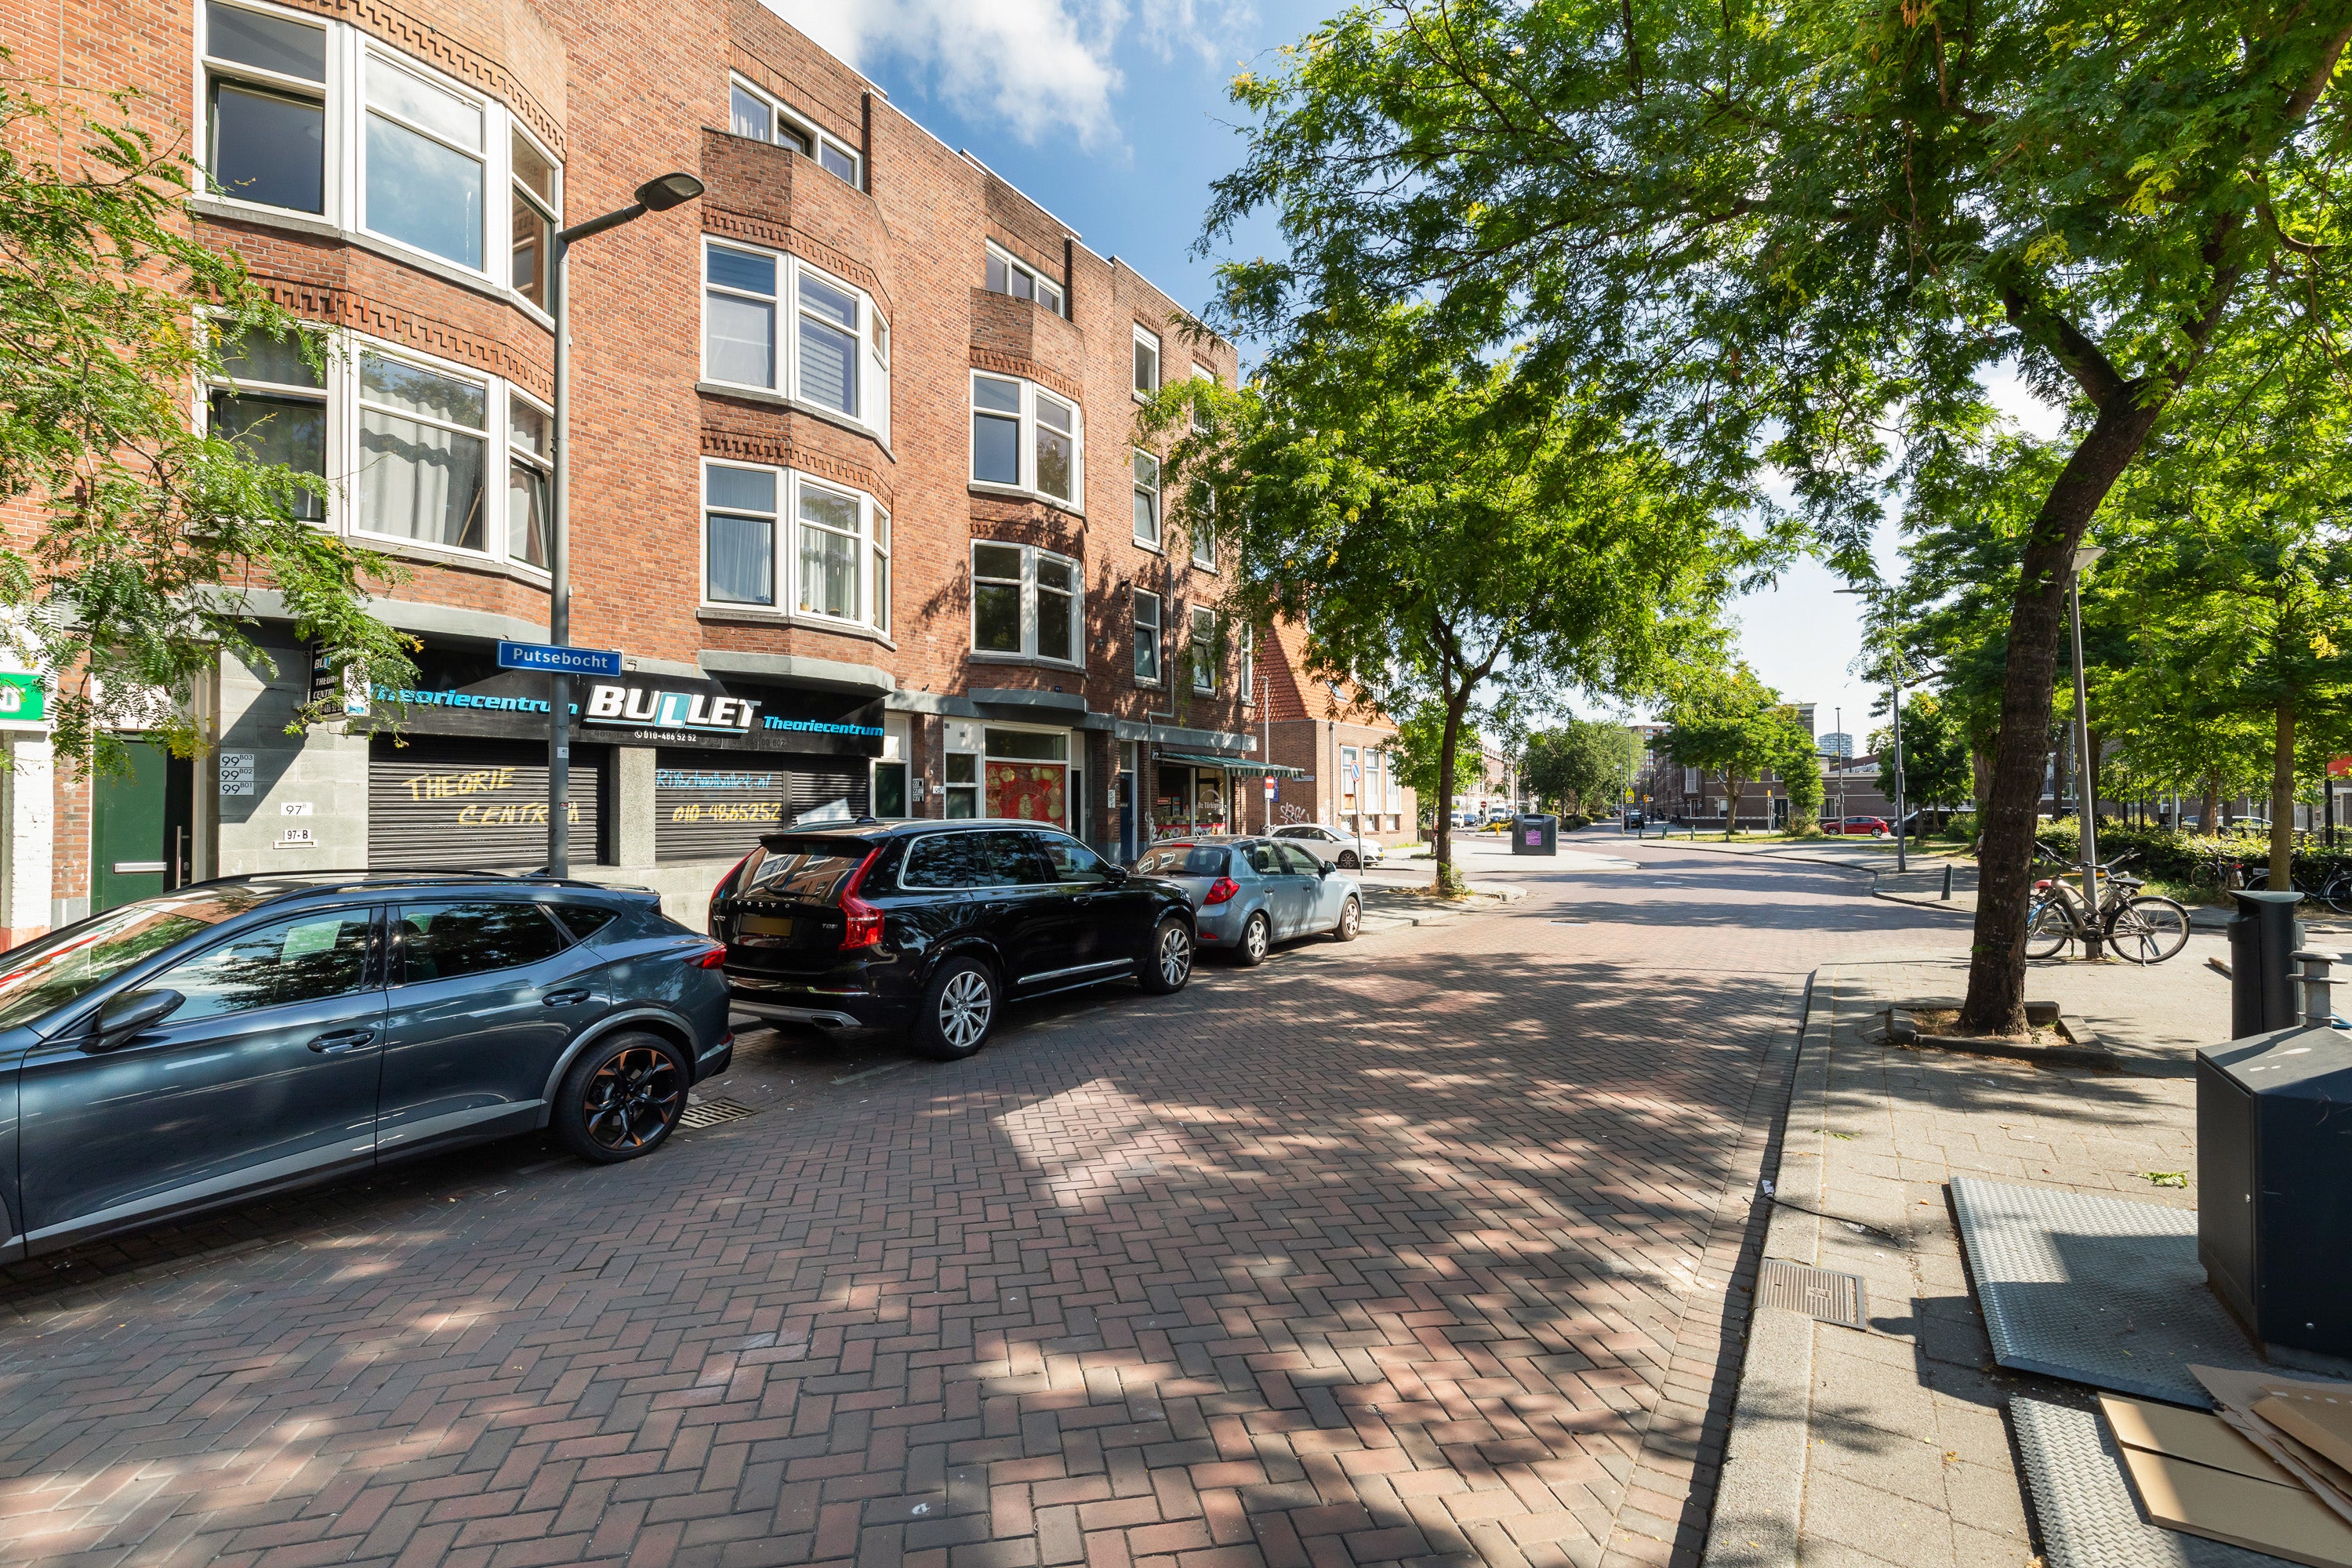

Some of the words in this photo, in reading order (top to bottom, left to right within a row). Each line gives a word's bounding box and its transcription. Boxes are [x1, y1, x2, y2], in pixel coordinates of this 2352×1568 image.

[513, 648, 608, 668] Putsebocht
[586, 684, 761, 729] BULLET
[644, 730, 674, 741] 010-486
[764, 716, 884, 737] Theoriecentrum
[401, 768, 516, 801] THEORIE
[672, 802, 781, 821] 010-4865252
[736, 900, 790, 909] VOLVO
